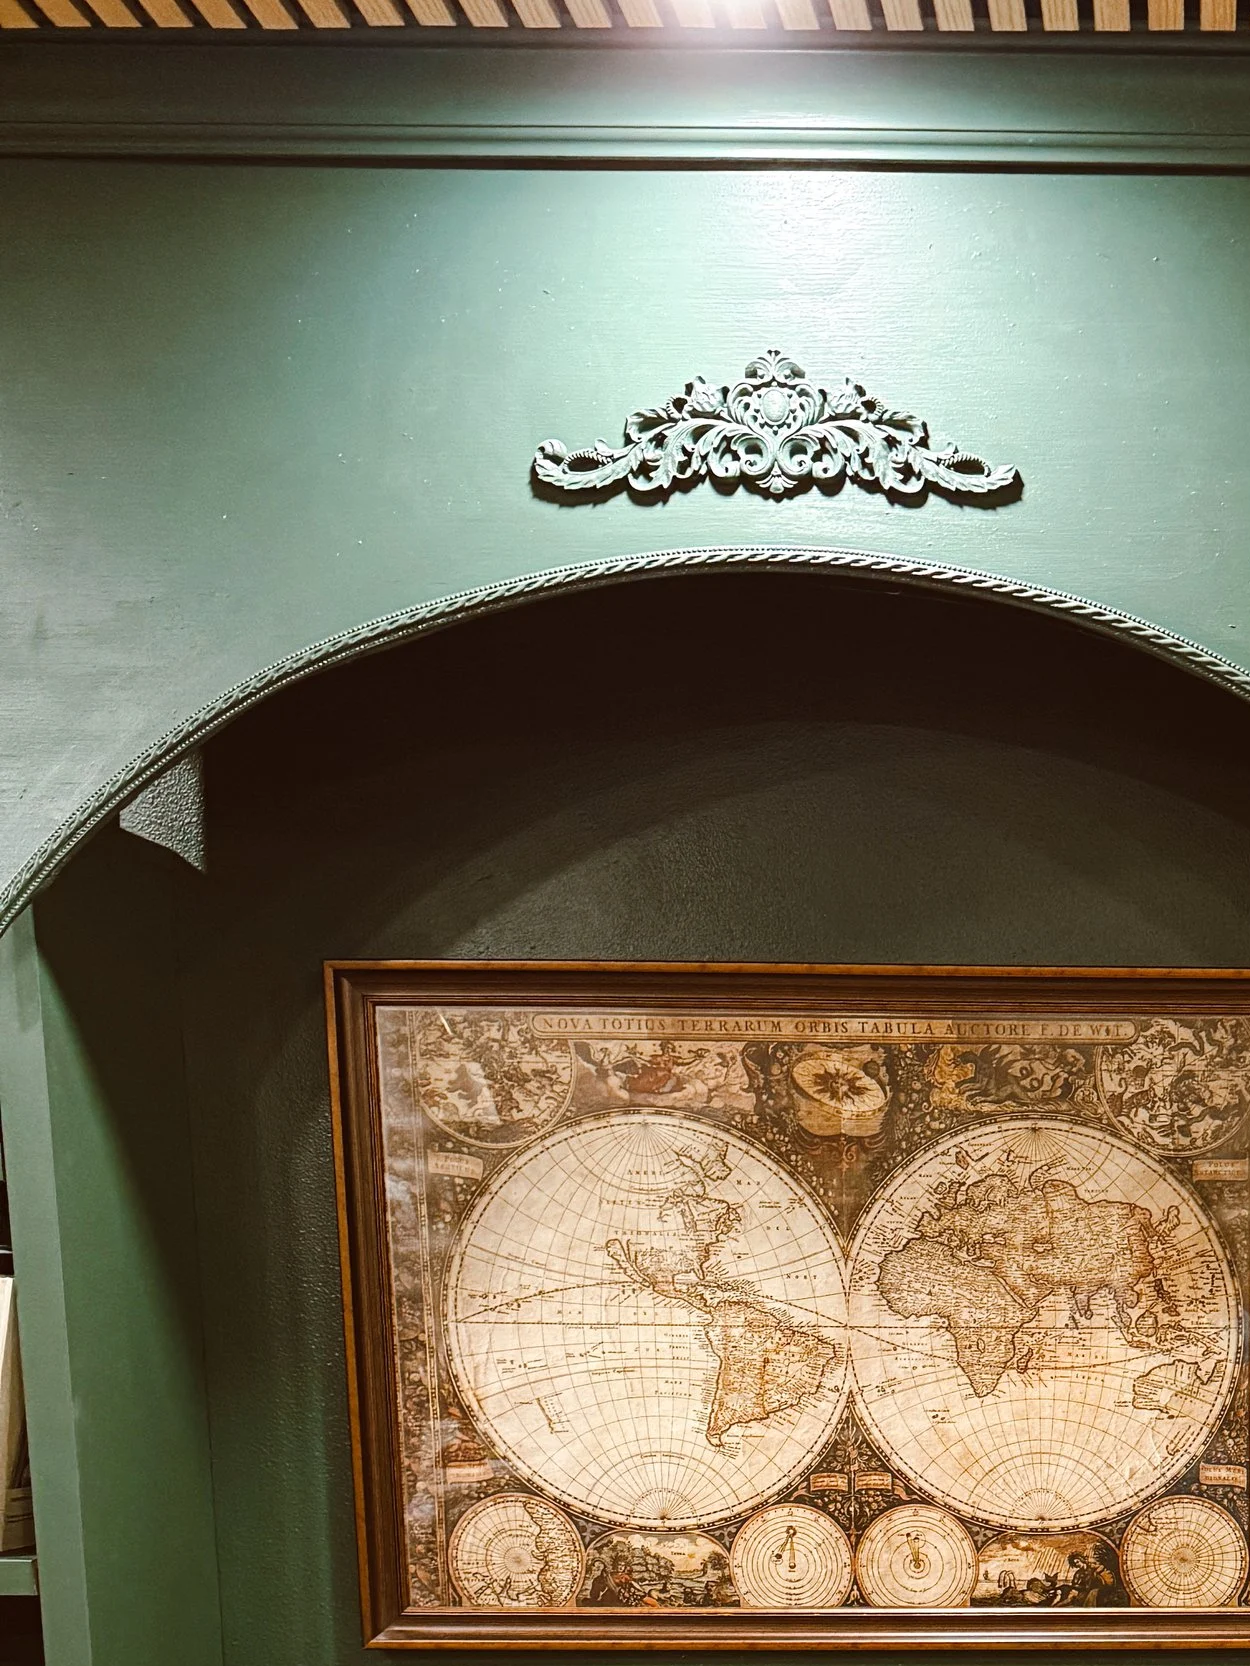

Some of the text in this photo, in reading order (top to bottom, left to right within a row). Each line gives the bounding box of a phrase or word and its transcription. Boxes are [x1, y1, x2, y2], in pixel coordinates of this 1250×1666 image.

[543, 1017, 592, 1031] NOVA
[600, 1017, 667, 1032] TOTIUS
[678, 1019, 783, 1033] TERRARUM
[795, 1020, 850, 1034] ORBIS
[858, 1021, 935, 1035] TABULA
[944, 1022, 1031, 1036] AUCTORE
[1058, 1024, 1083, 1037] DE
